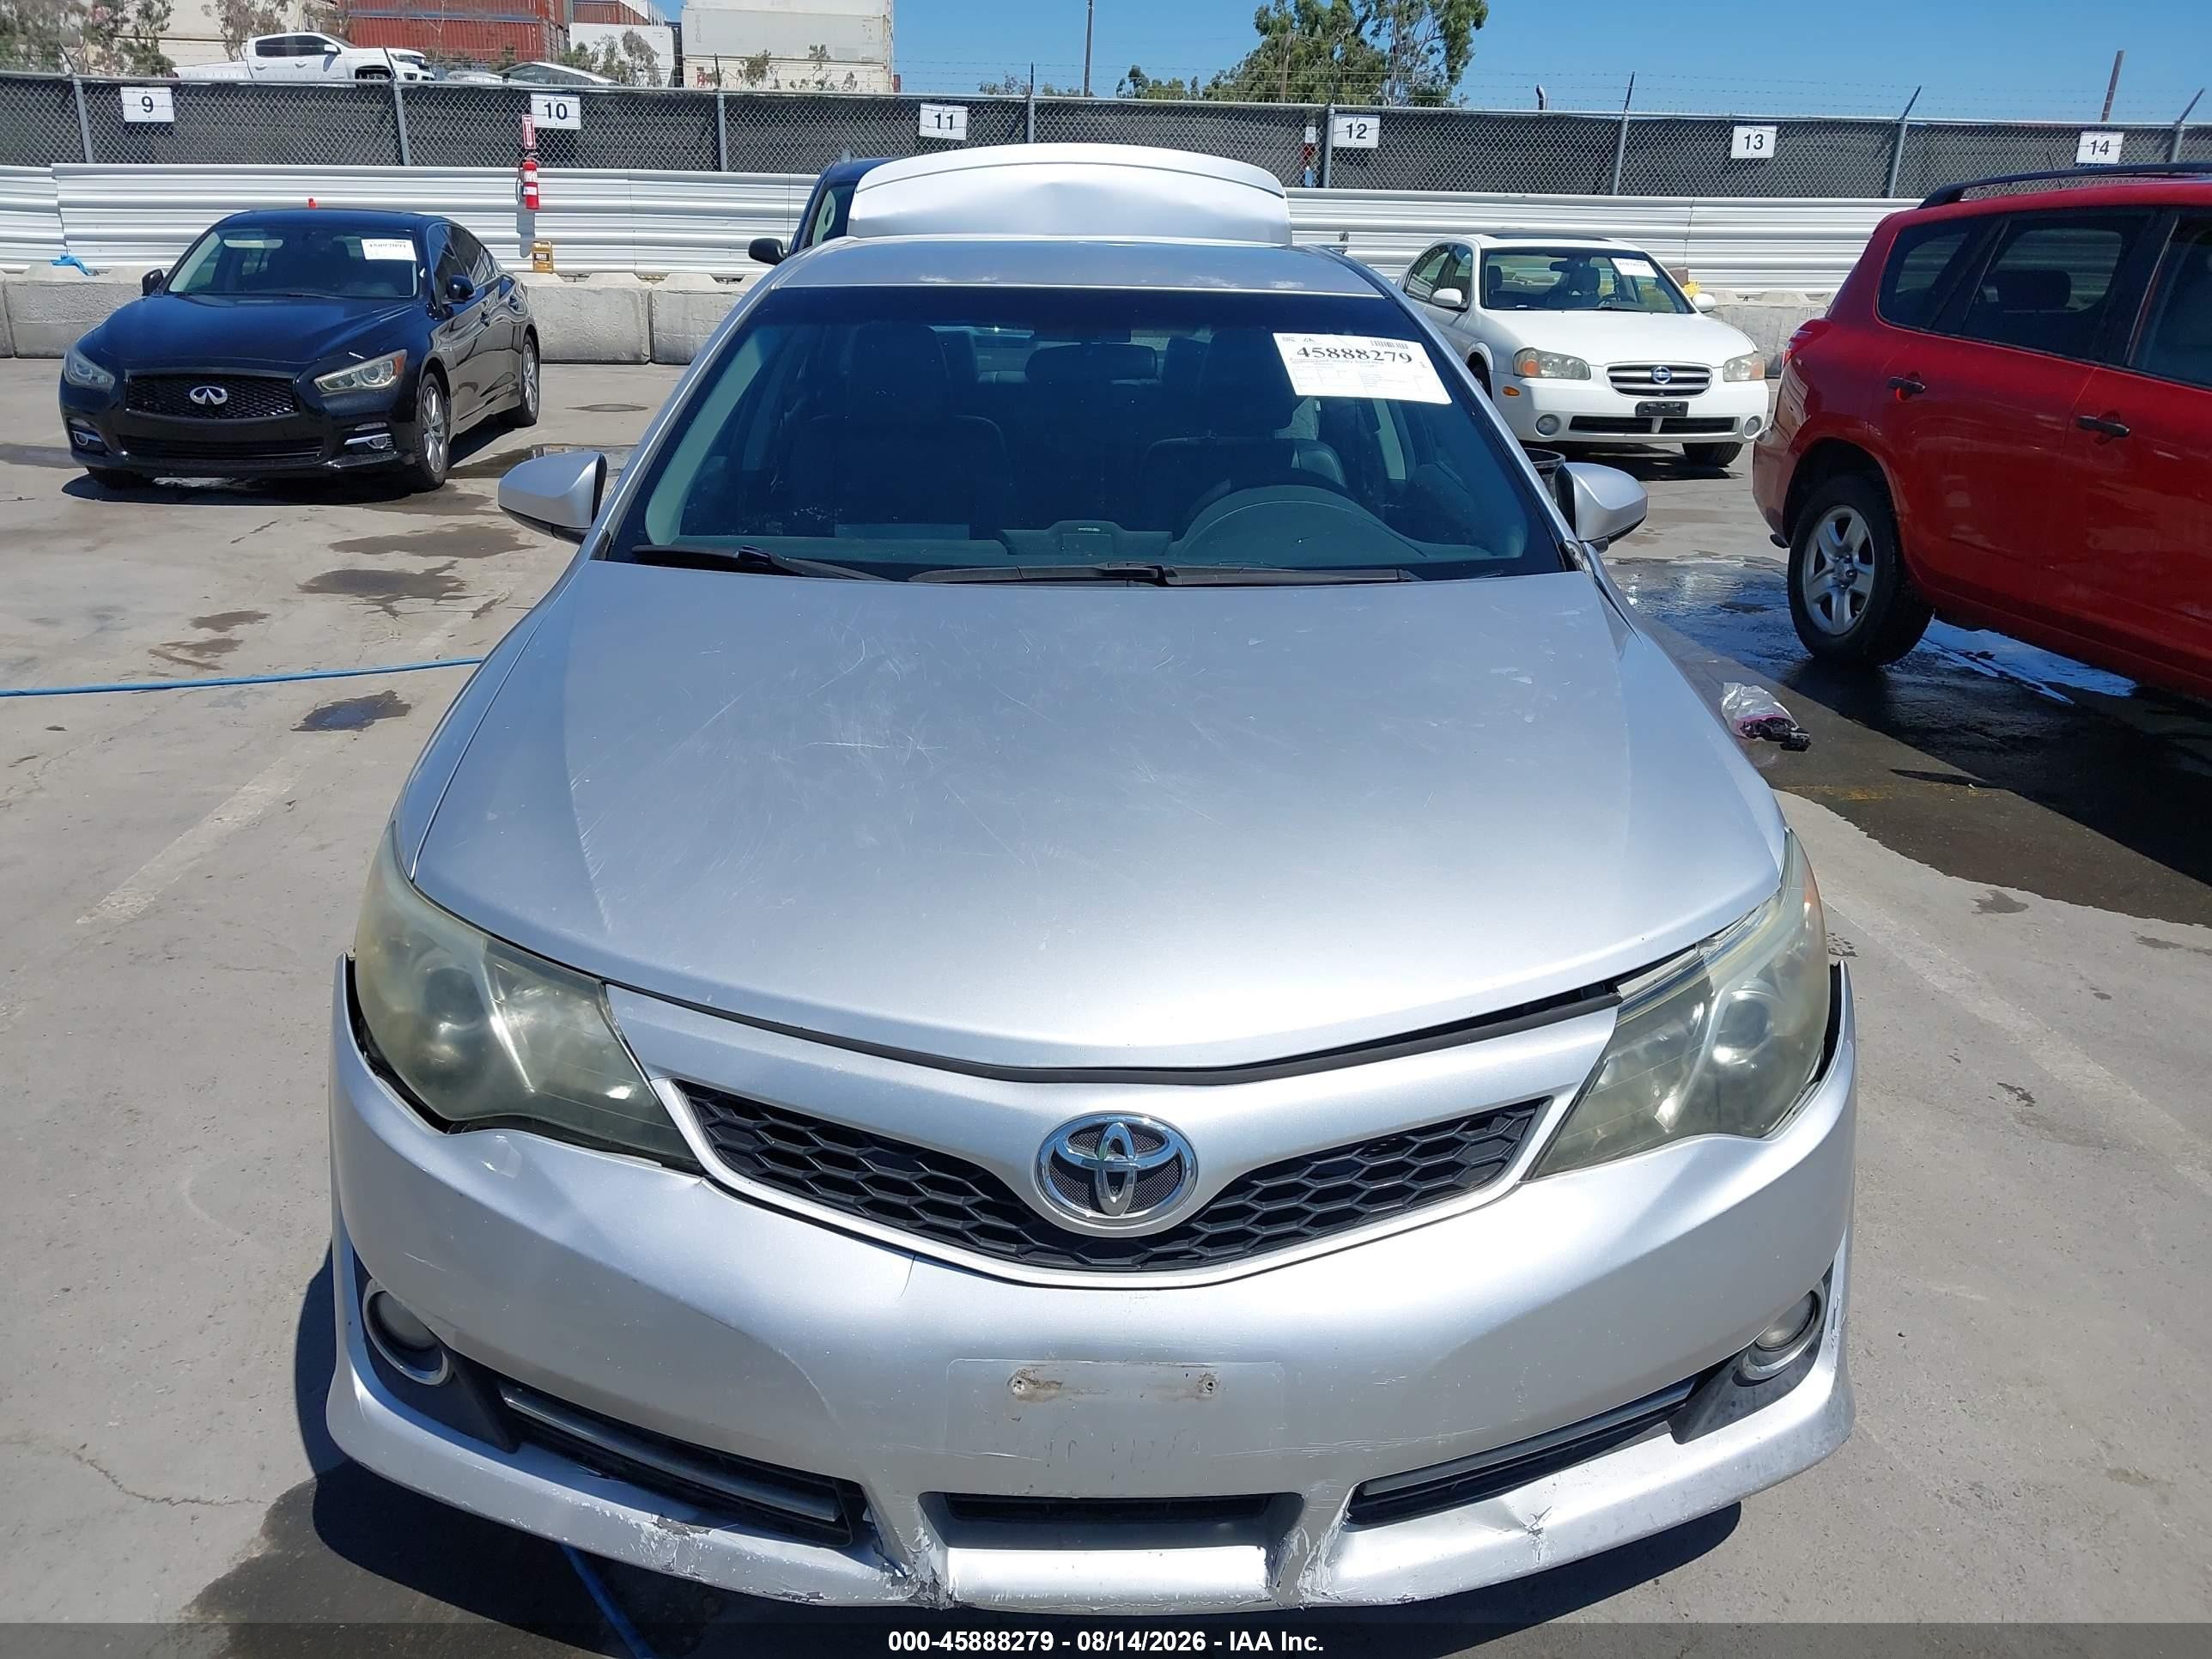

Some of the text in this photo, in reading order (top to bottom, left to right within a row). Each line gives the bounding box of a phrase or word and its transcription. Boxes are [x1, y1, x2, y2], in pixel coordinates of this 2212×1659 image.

[141, 95, 154, 113] 9
[544, 102, 568, 120] 10
[934, 112, 954, 131] 11
[1346, 123, 1367, 139] 12
[1744, 134, 1764, 150] 13
[2090, 140, 2110, 155] 14
[1297, 346, 1413, 363] 45888279
